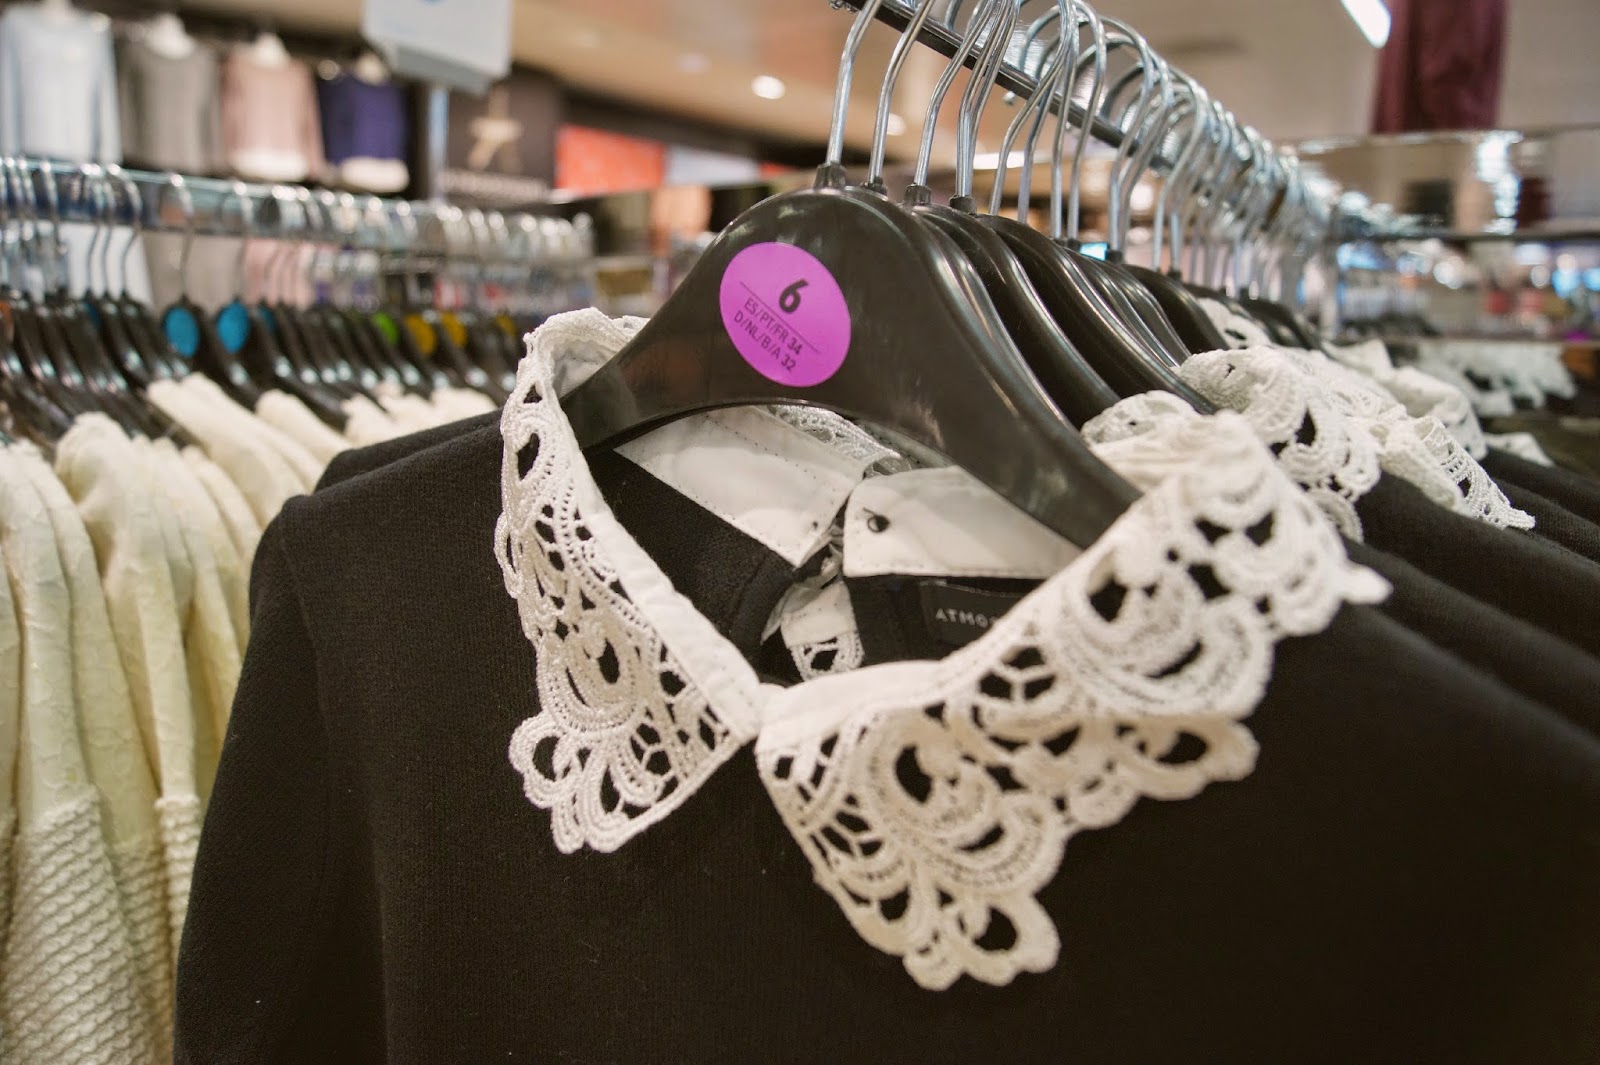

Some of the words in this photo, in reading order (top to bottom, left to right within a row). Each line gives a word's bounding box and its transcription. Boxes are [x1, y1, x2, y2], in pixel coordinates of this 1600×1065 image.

[779, 279, 808, 313] 6
[734, 310, 780, 359] D/NL/B/A
[780, 353, 797, 371] 32
[744, 298, 789, 343] ES/PT/FR
[787, 336, 803, 355] 34
